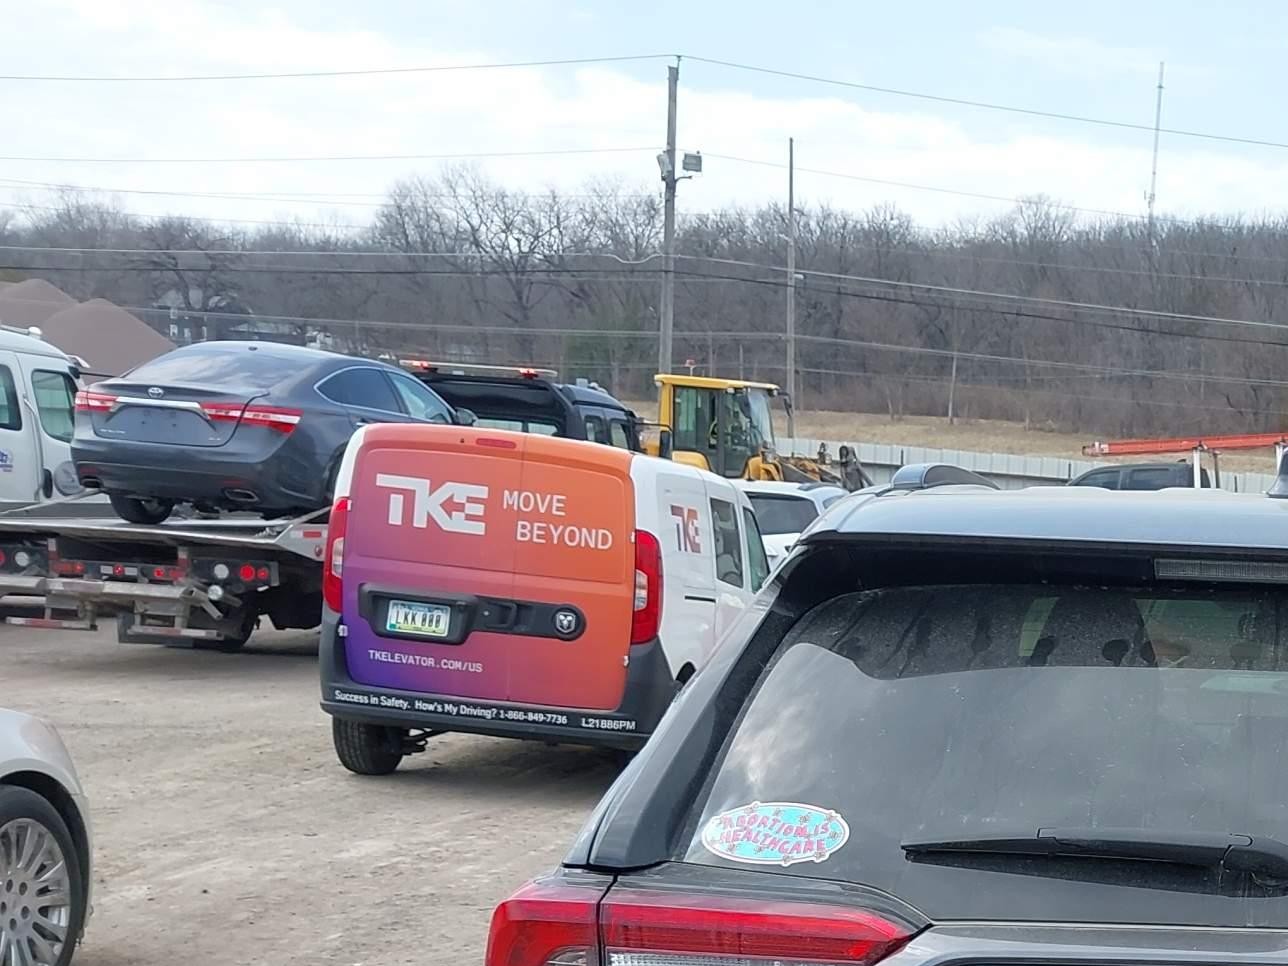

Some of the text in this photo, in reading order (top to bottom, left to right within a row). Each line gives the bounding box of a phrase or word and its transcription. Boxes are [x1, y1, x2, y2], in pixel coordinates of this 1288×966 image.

[376, 473, 489, 536] TKE
[503, 489, 567, 516] MOVE
[516, 521, 613, 550] BEYOND
[670, 504, 702, 554] TKE
[368, 649, 484, 673] TKELEVATOR.COM/US
[334, 690, 369, 704] Success
[370, 694, 379, 705] in
[380, 695, 411, 710] Safety.
[415, 700, 443, 713] How's
[444, 703, 458, 716] My
[460, 704, 497, 720] Driving?
[720, 814, 830, 838] ABORTION IS
[720, 827, 827, 855] HEALTHCARE
